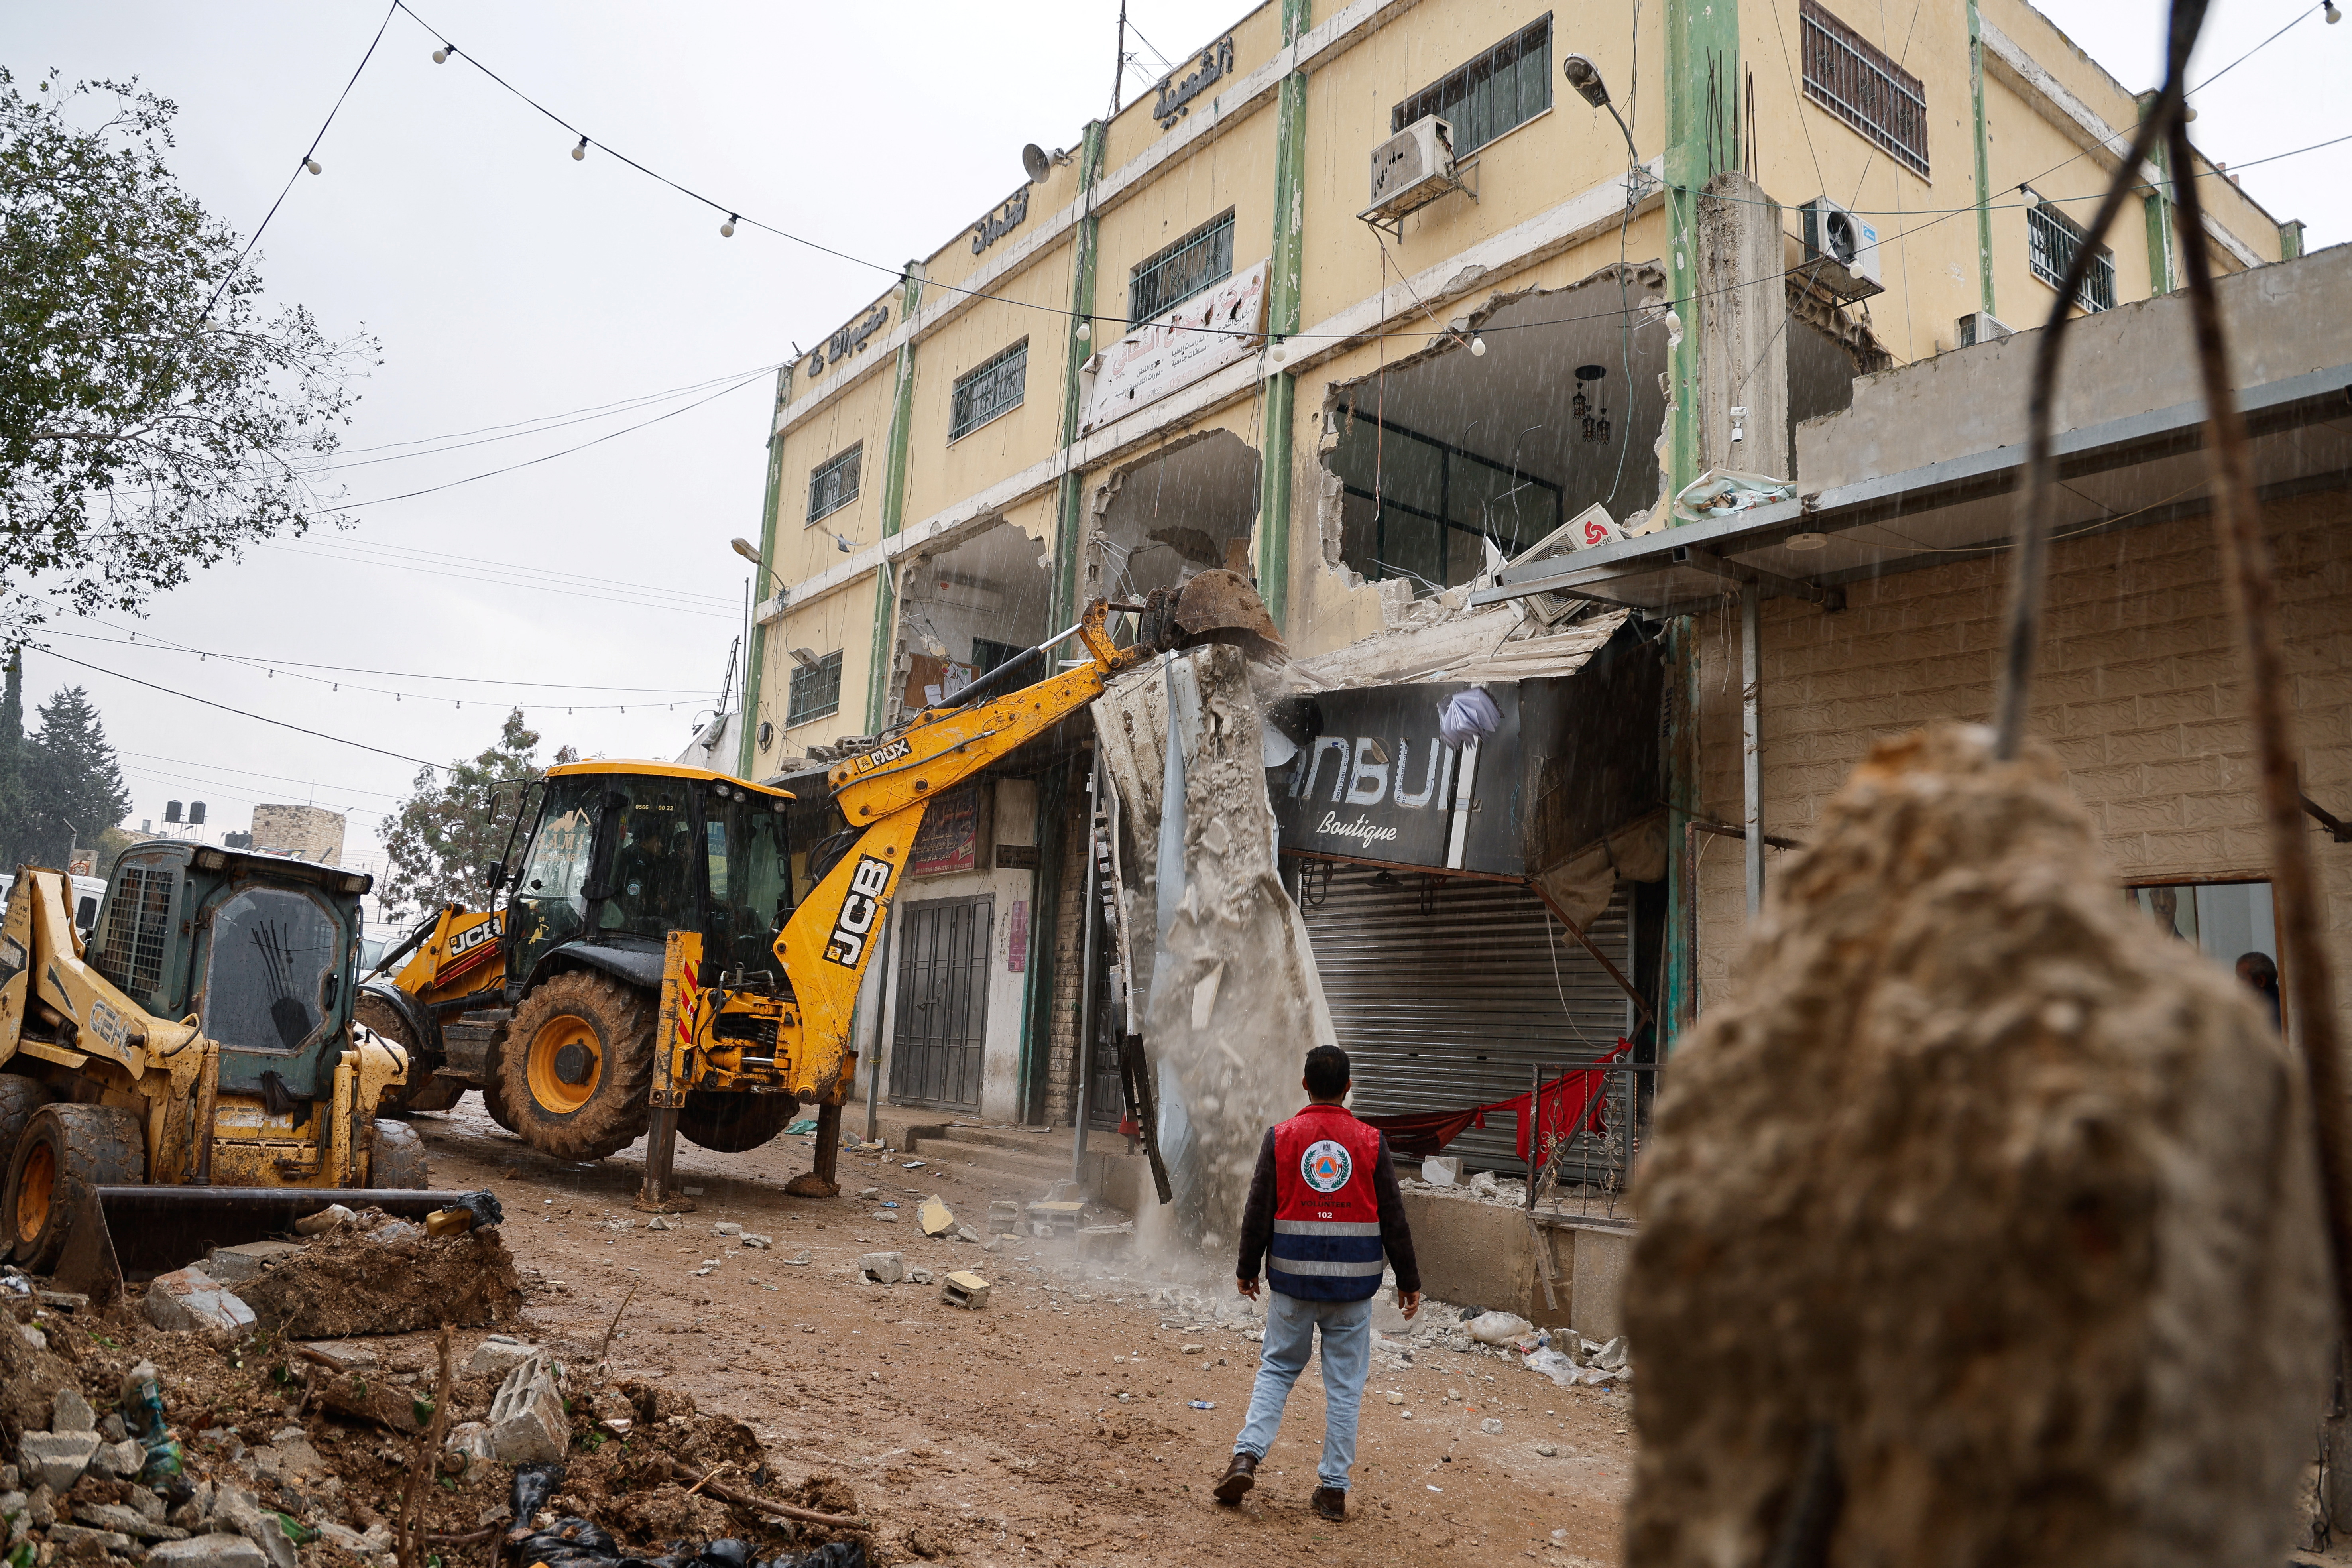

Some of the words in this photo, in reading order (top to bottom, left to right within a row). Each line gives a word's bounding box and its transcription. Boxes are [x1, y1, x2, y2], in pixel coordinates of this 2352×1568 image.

[1215, 275, 1262, 320] مركز
[1163, 293, 1215, 348] النجاح
[1112, 324, 1160, 380] الثقافي
[1172, 345, 1184, 357] العليا
[1185, 334, 1206, 350] الدراسات
[1137, 365, 1150, 378] النطق
[1148, 371, 1160, 380] دورات
[1171, 354, 1187, 368] جامعية
[1316, 810, 1397, 848] Boutique
[834, 859, 889, 965] JCB
[452, 918, 501, 954] JCB
